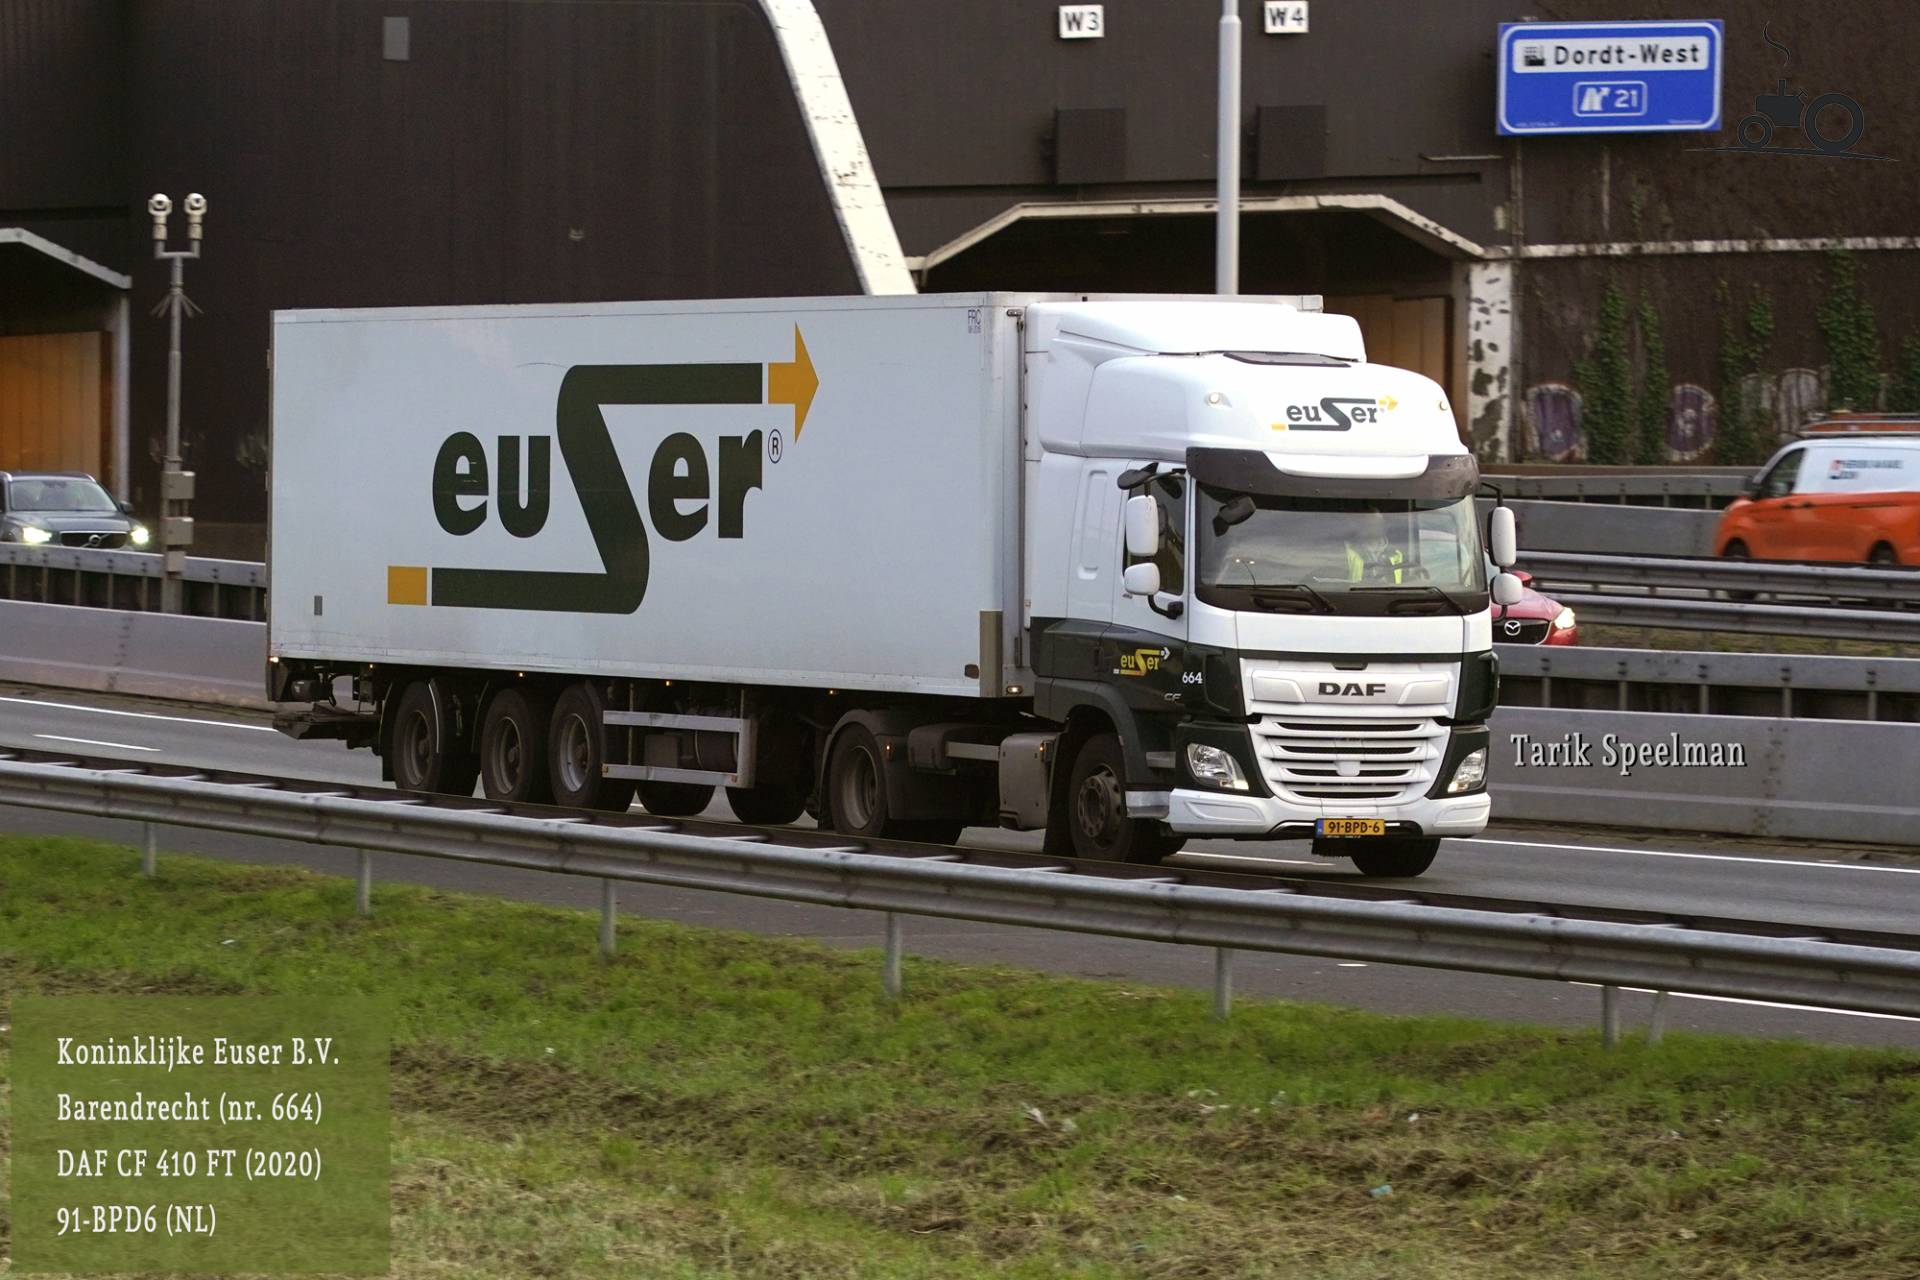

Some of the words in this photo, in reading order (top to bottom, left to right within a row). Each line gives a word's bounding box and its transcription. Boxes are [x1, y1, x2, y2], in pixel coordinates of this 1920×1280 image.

[1064, 11, 1100, 31] W3
[1269, 7, 1304, 27] W4
[1554, 44, 1700, 65] Dordt-West
[1614, 89, 1638, 108] 21
[1182, 672, 1203, 684] 664
[1319, 683, 1386, 696] DAF
[1328, 821, 1380, 833] 91-BPD-6
